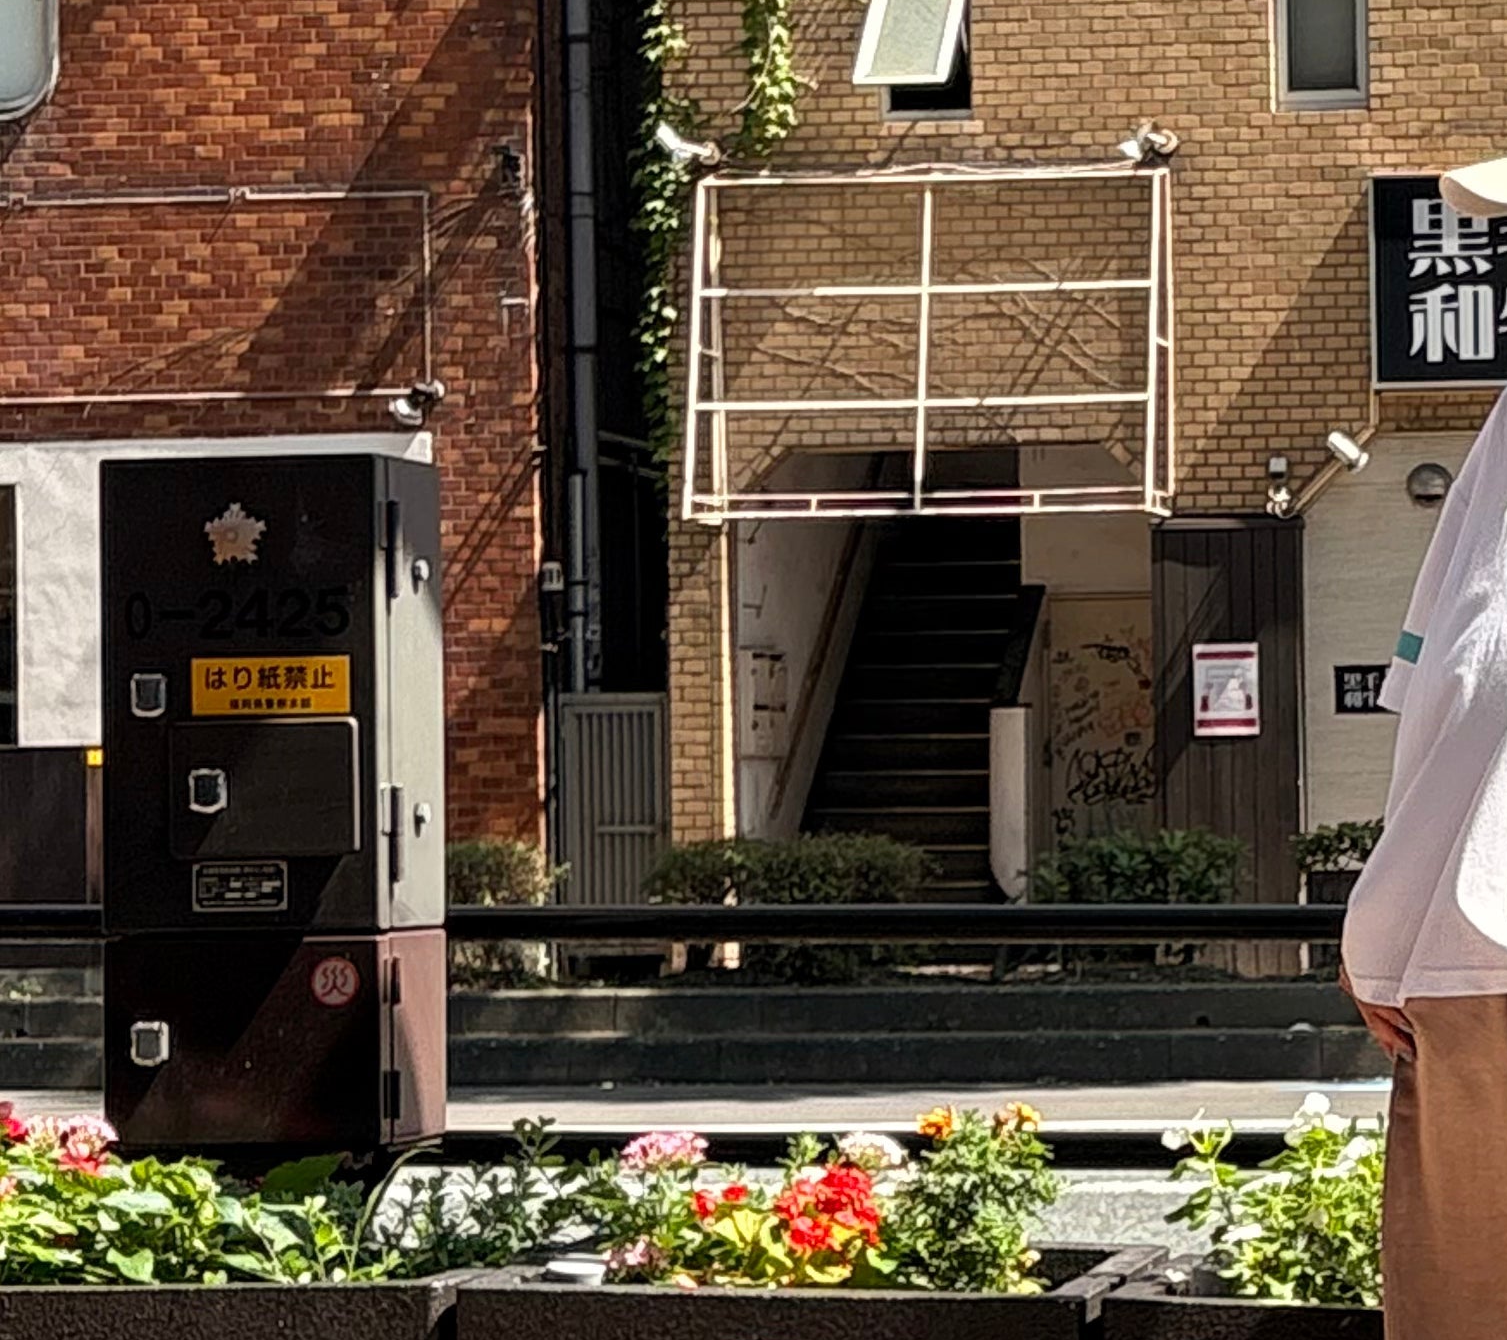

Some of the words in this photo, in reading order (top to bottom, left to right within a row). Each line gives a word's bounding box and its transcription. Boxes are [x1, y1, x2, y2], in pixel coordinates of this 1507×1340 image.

[204, 664, 336, 691] はり紙禁止
